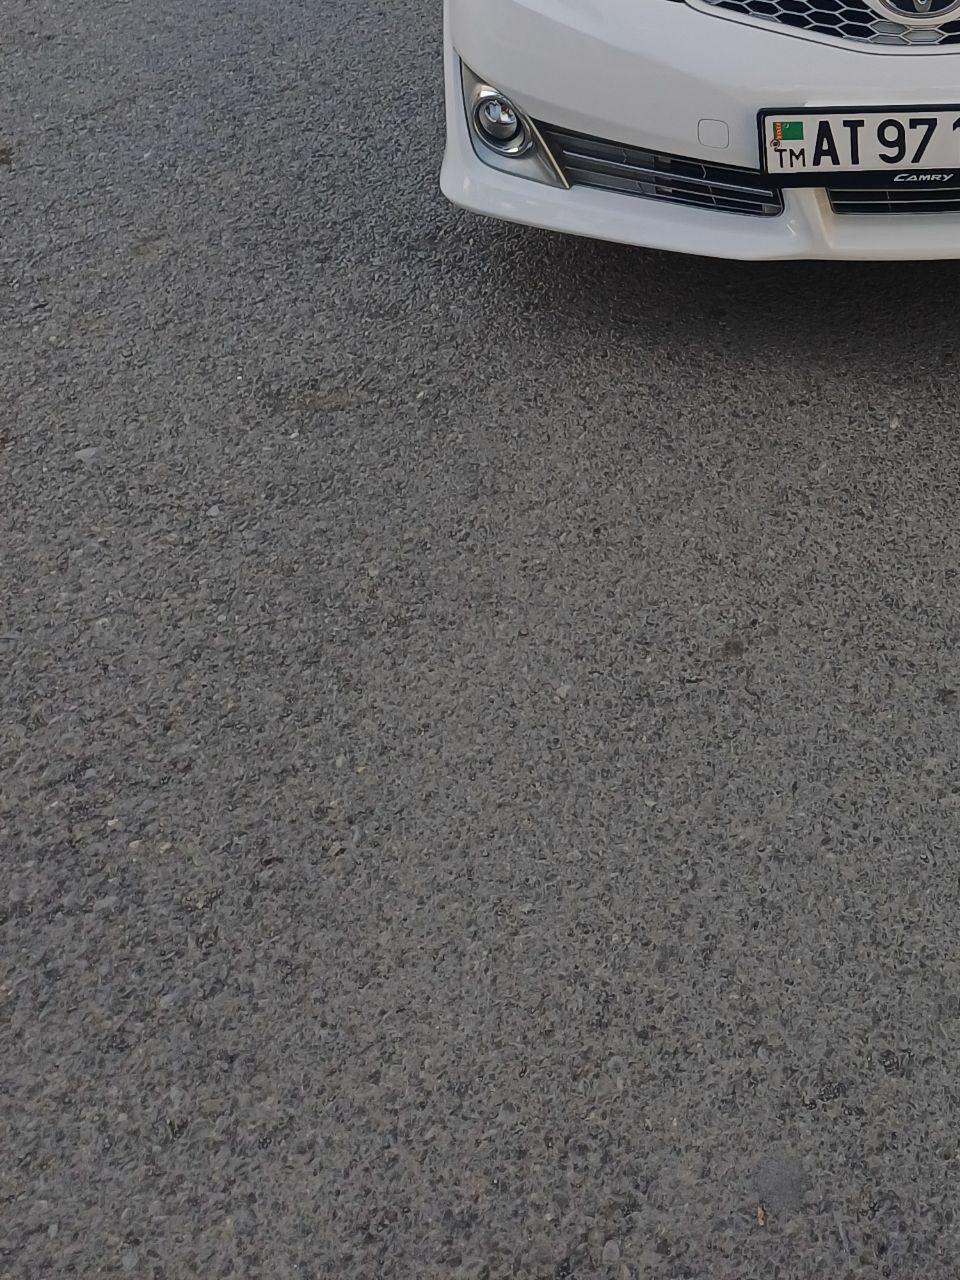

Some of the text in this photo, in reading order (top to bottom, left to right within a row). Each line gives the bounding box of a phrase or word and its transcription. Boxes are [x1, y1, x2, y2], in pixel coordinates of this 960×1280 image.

[812, 119, 865, 167] AT
[876, 117, 938, 164] 97
[774, 147, 806, 168] TM
[893, 172, 954, 182] CAMRY
